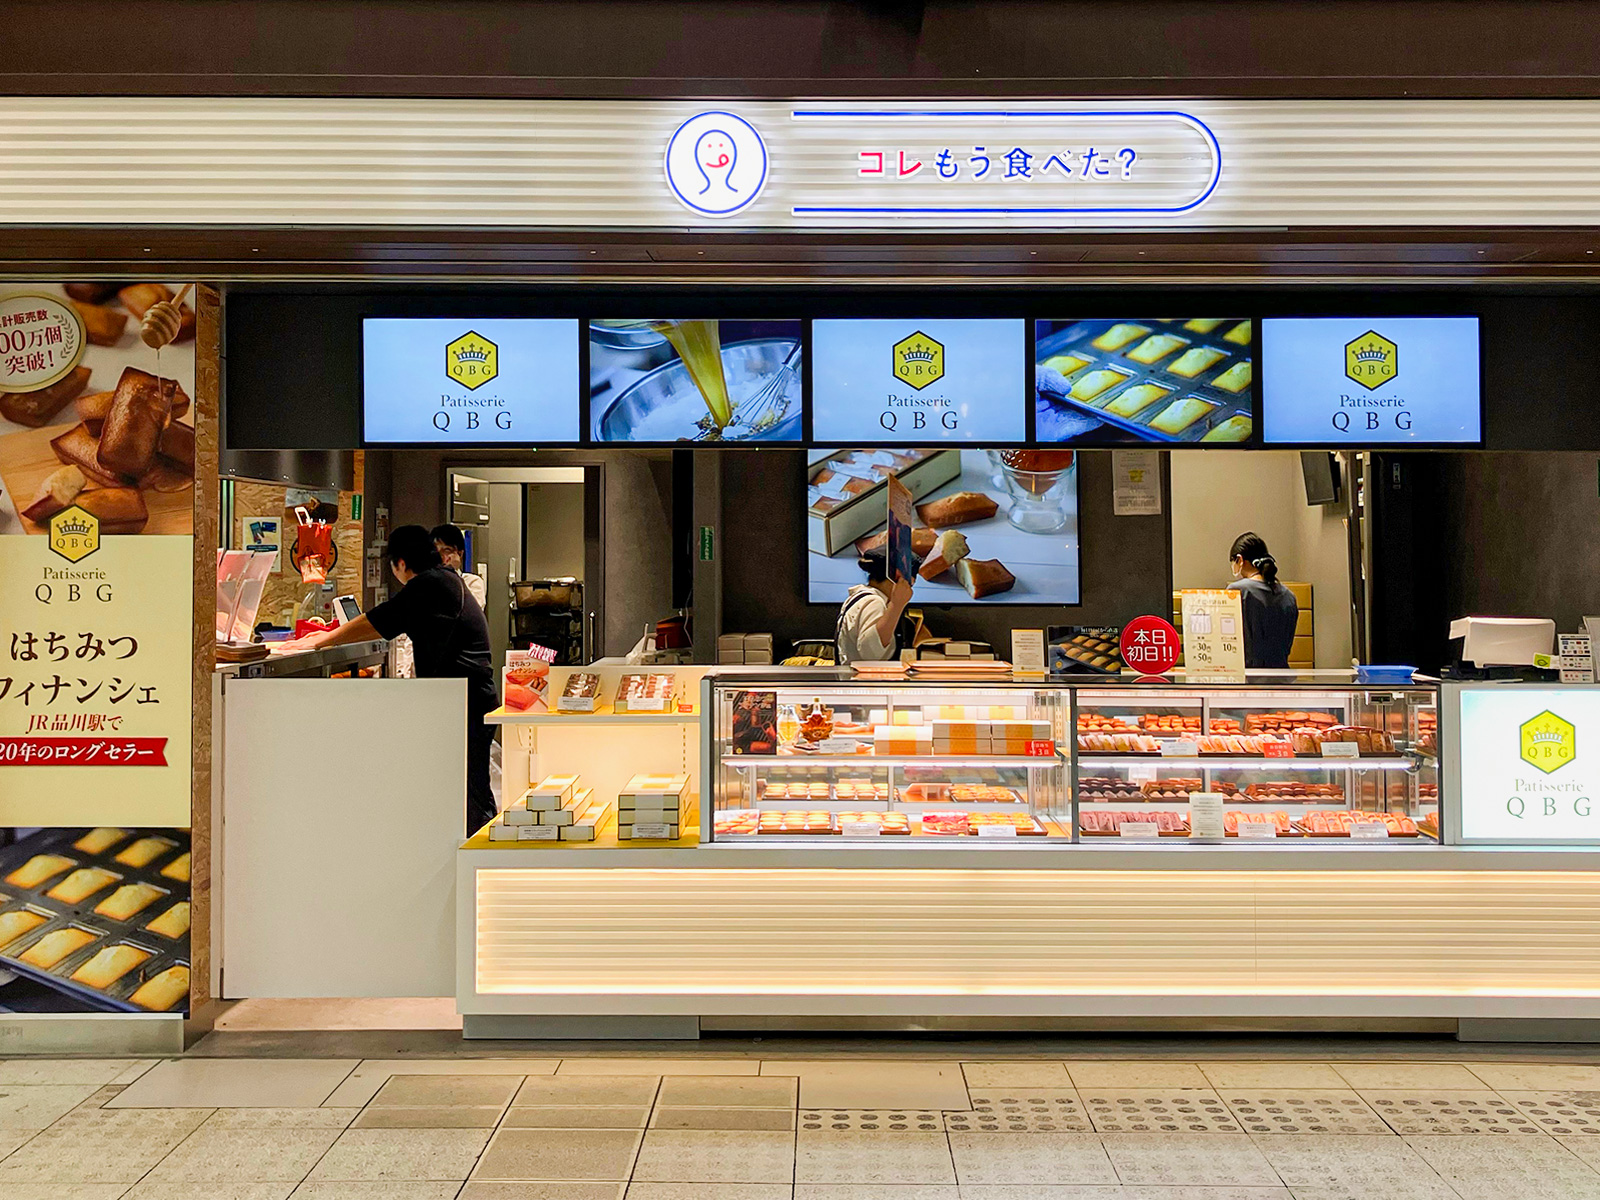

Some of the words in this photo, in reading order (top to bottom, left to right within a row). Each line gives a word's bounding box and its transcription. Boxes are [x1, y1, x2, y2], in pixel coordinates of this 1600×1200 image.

[860, 147, 1137, 179] コレもう食べた?
[0, 309, 49, 328] 計販売数
[5, 349, 55, 377] 突破!
[453, 364, 491, 376] QBG
[900, 364, 938, 377] QBG
[1352, 364, 1390, 376] QBG
[440, 394, 505, 407] Patisserie
[887, 394, 951, 407] Patisserie
[1339, 394, 1405, 407] Patisserie
[432, 411, 513, 431] QBG
[879, 411, 959, 431] QBG
[1332, 411, 1413, 432] QBG
[56, 537, 94, 549] QBG
[43, 567, 107, 580] Patisserie
[35, 583, 113, 604] QBG
[1133, 629, 1167, 645] 本日
[10, 631, 139, 662] はちみつ
[1126, 646, 1174, 662] 初日!!
[25, 713, 124, 734] JR品川駅で
[1527, 747, 1568, 758] QBG
[1515, 778, 1584, 792] Patisserie
[1506, 796, 1592, 819] QBG
